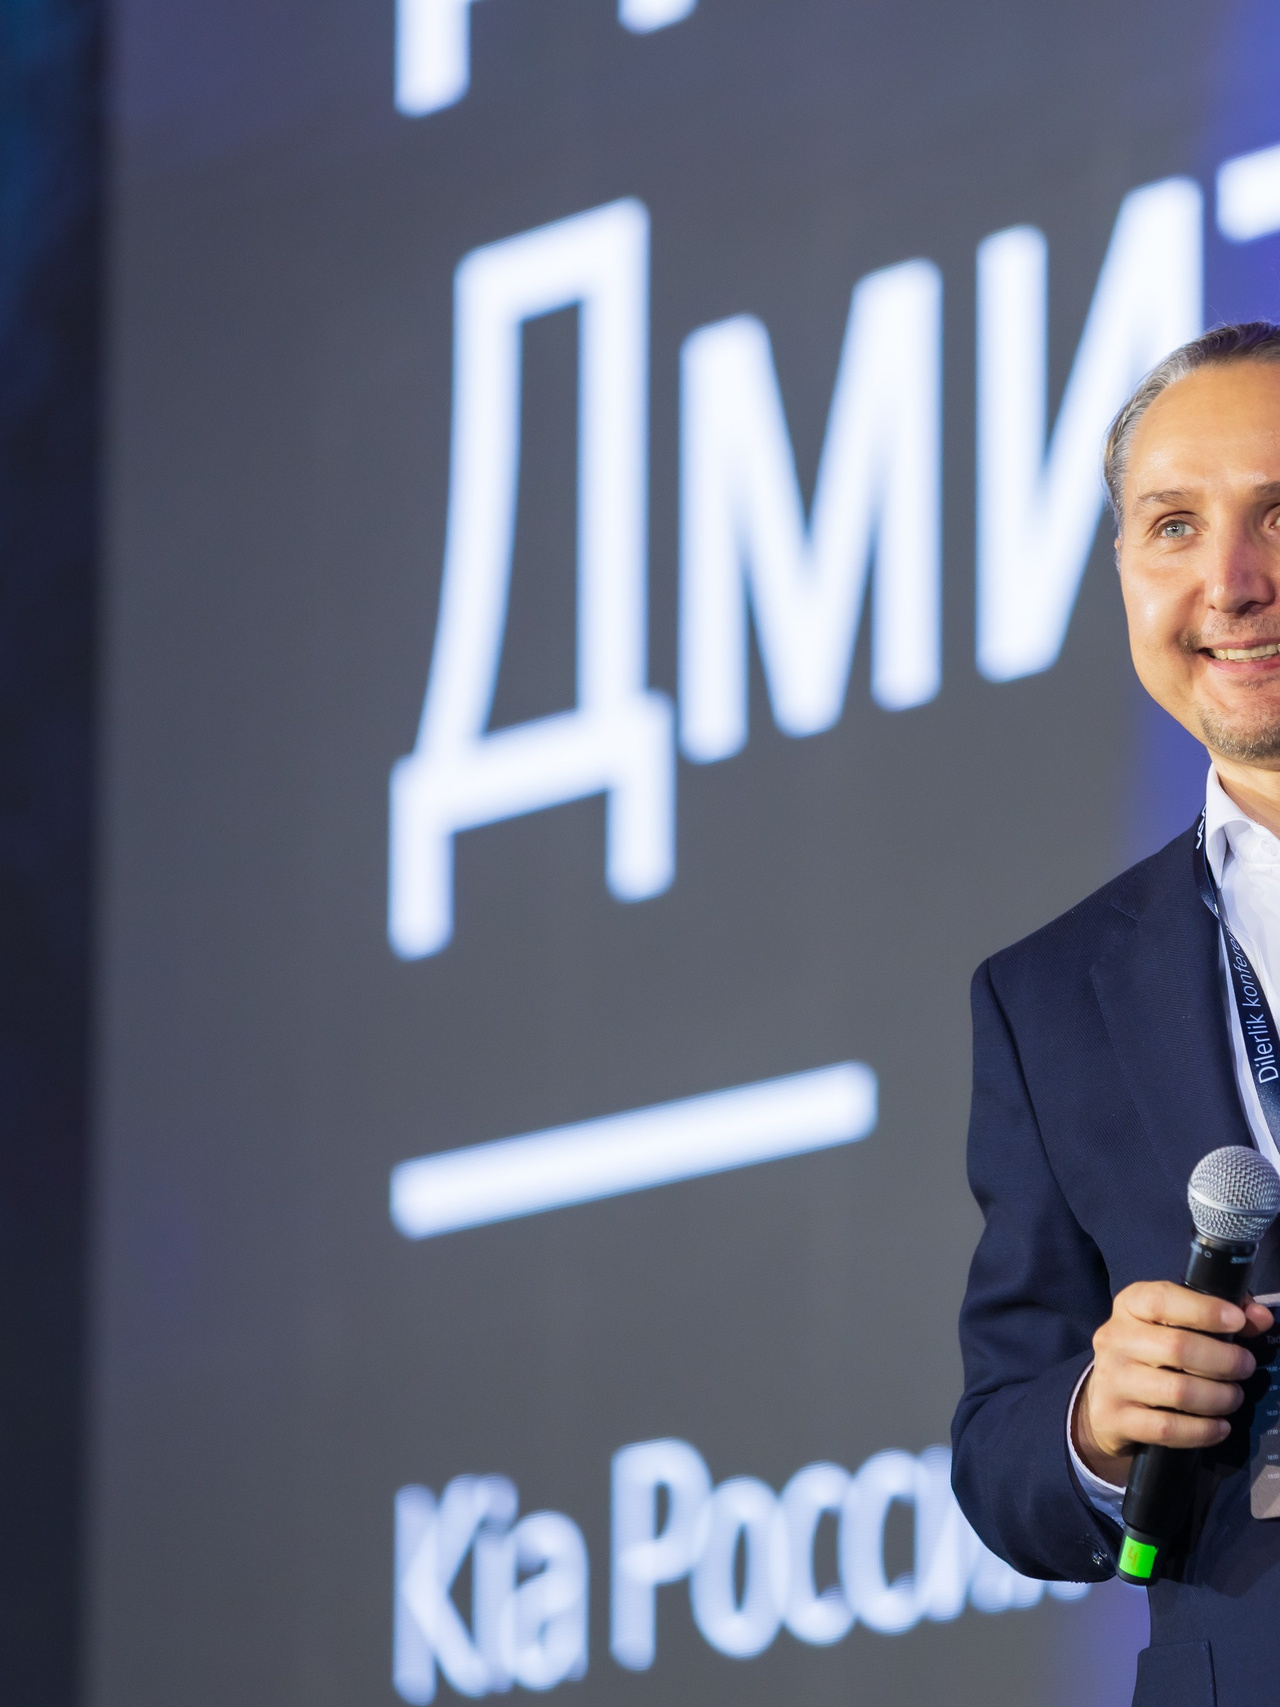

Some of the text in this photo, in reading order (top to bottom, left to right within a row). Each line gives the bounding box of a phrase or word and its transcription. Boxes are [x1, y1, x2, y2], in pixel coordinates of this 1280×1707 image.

[1246, 1013, 1280, 1084] Dilerlik
[392, 1436, 1093, 1706] Kia Росси
